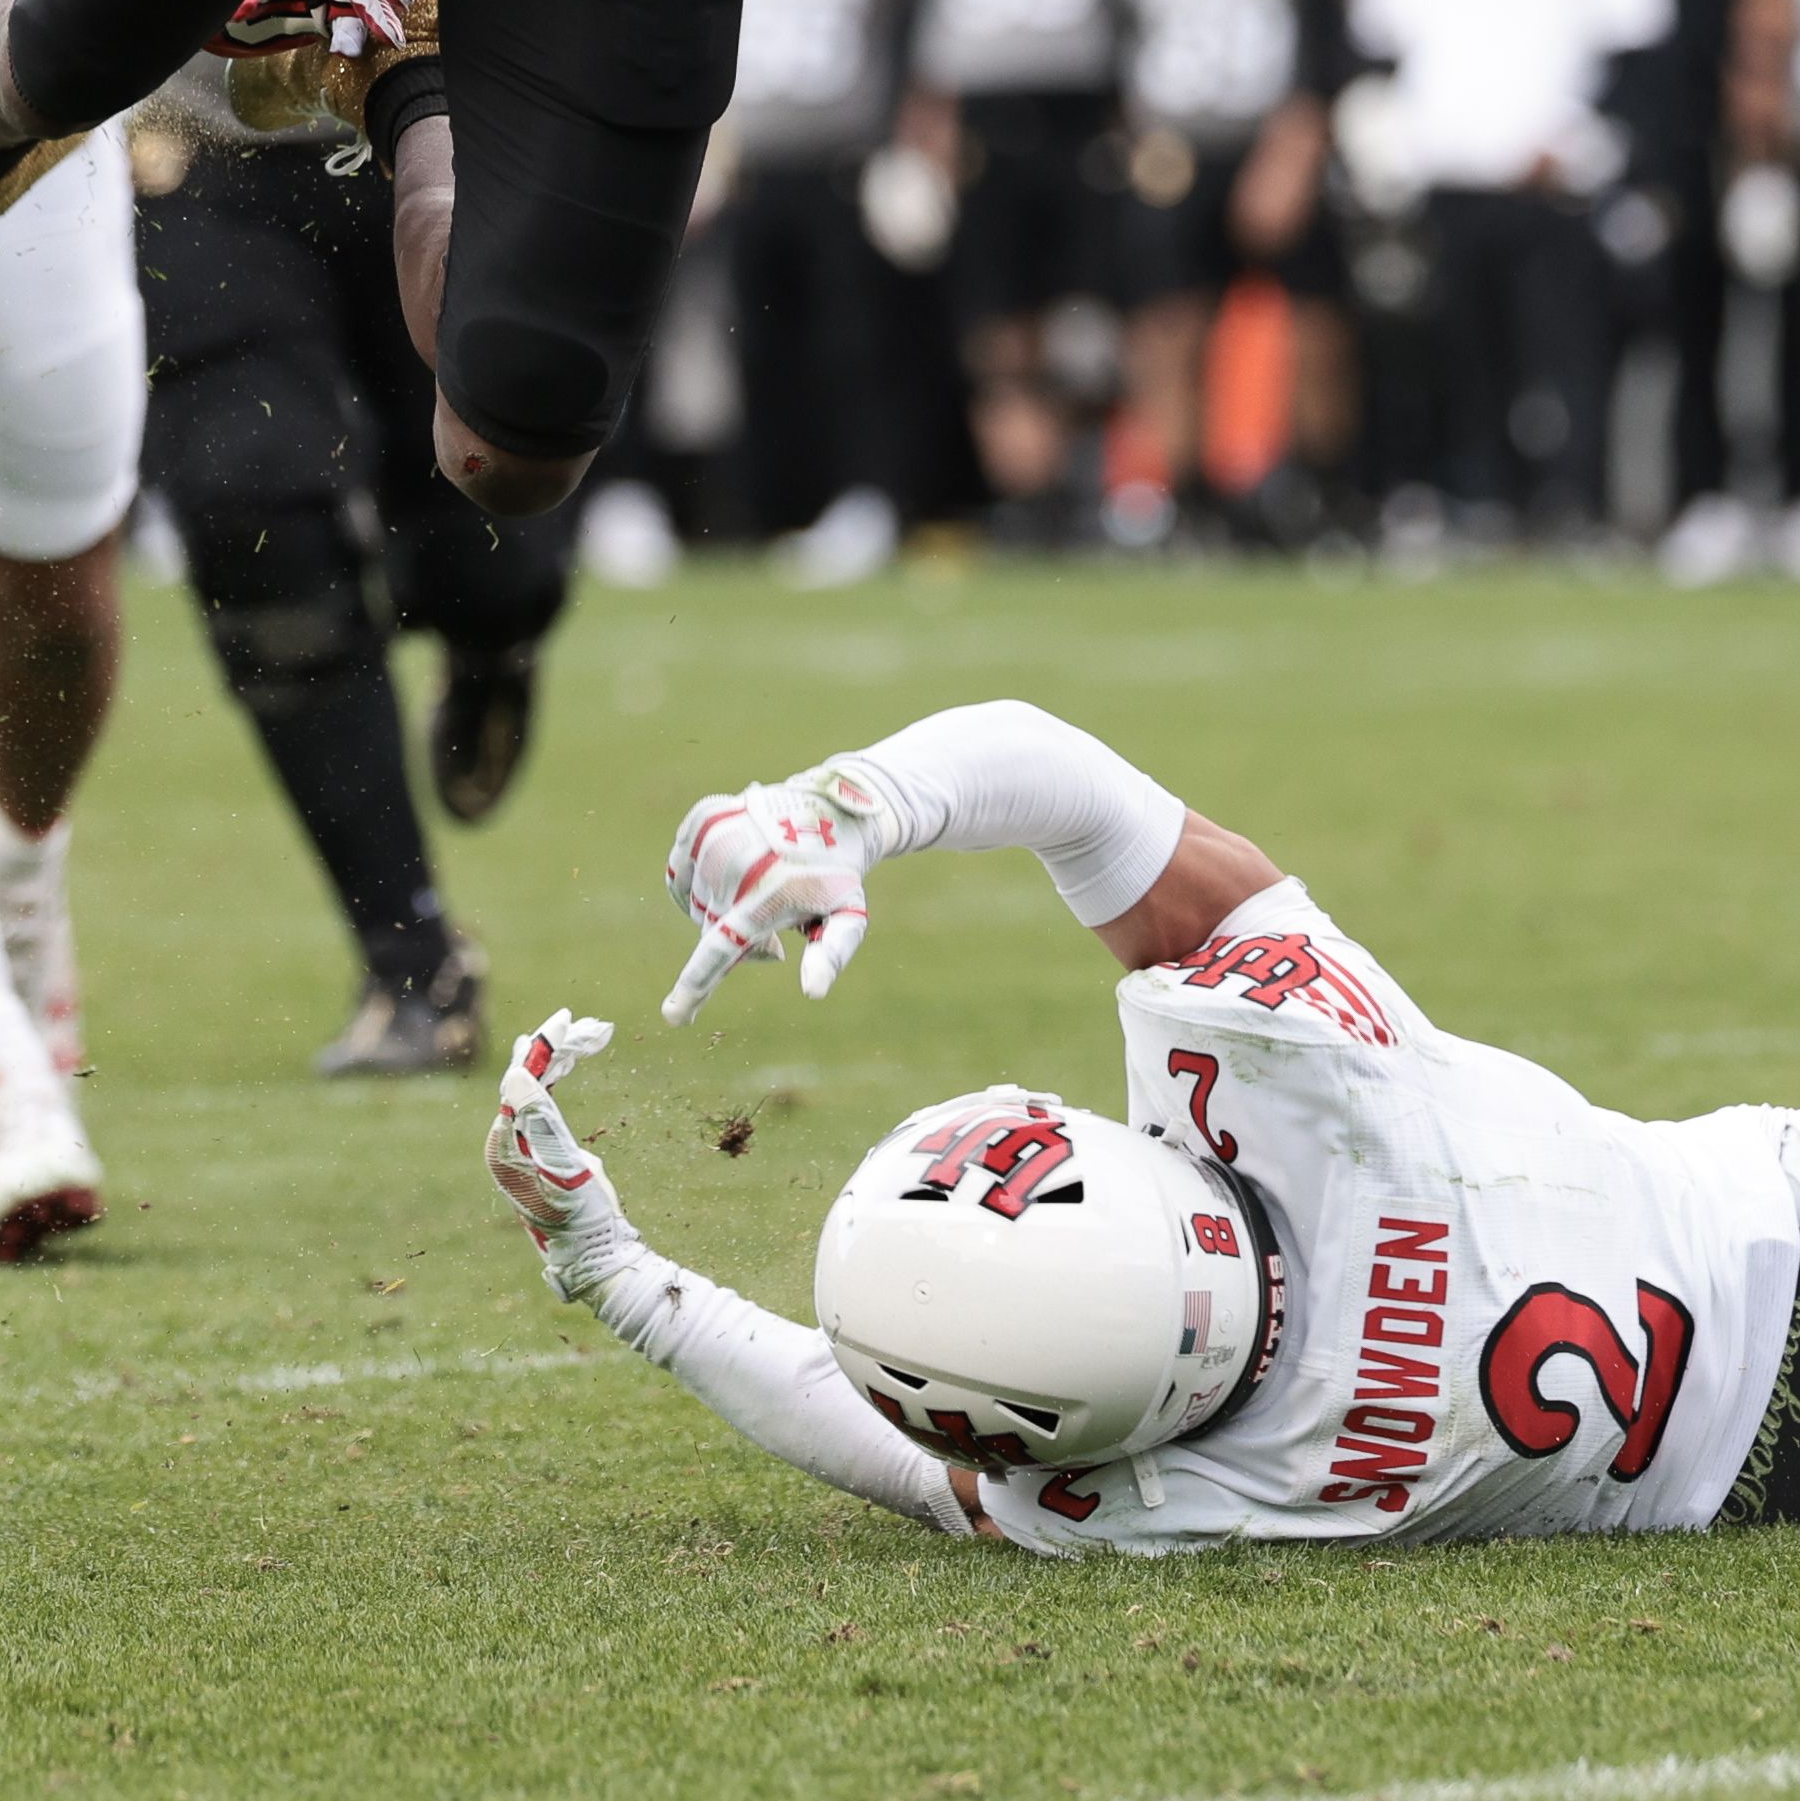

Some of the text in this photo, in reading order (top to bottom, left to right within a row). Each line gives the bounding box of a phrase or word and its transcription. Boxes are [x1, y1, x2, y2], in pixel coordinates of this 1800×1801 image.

[1167, 1048, 1239, 1165] 2
[1318, 1216, 1450, 1514] SNOWDEN
[1478, 1276, 1695, 1484] 2
